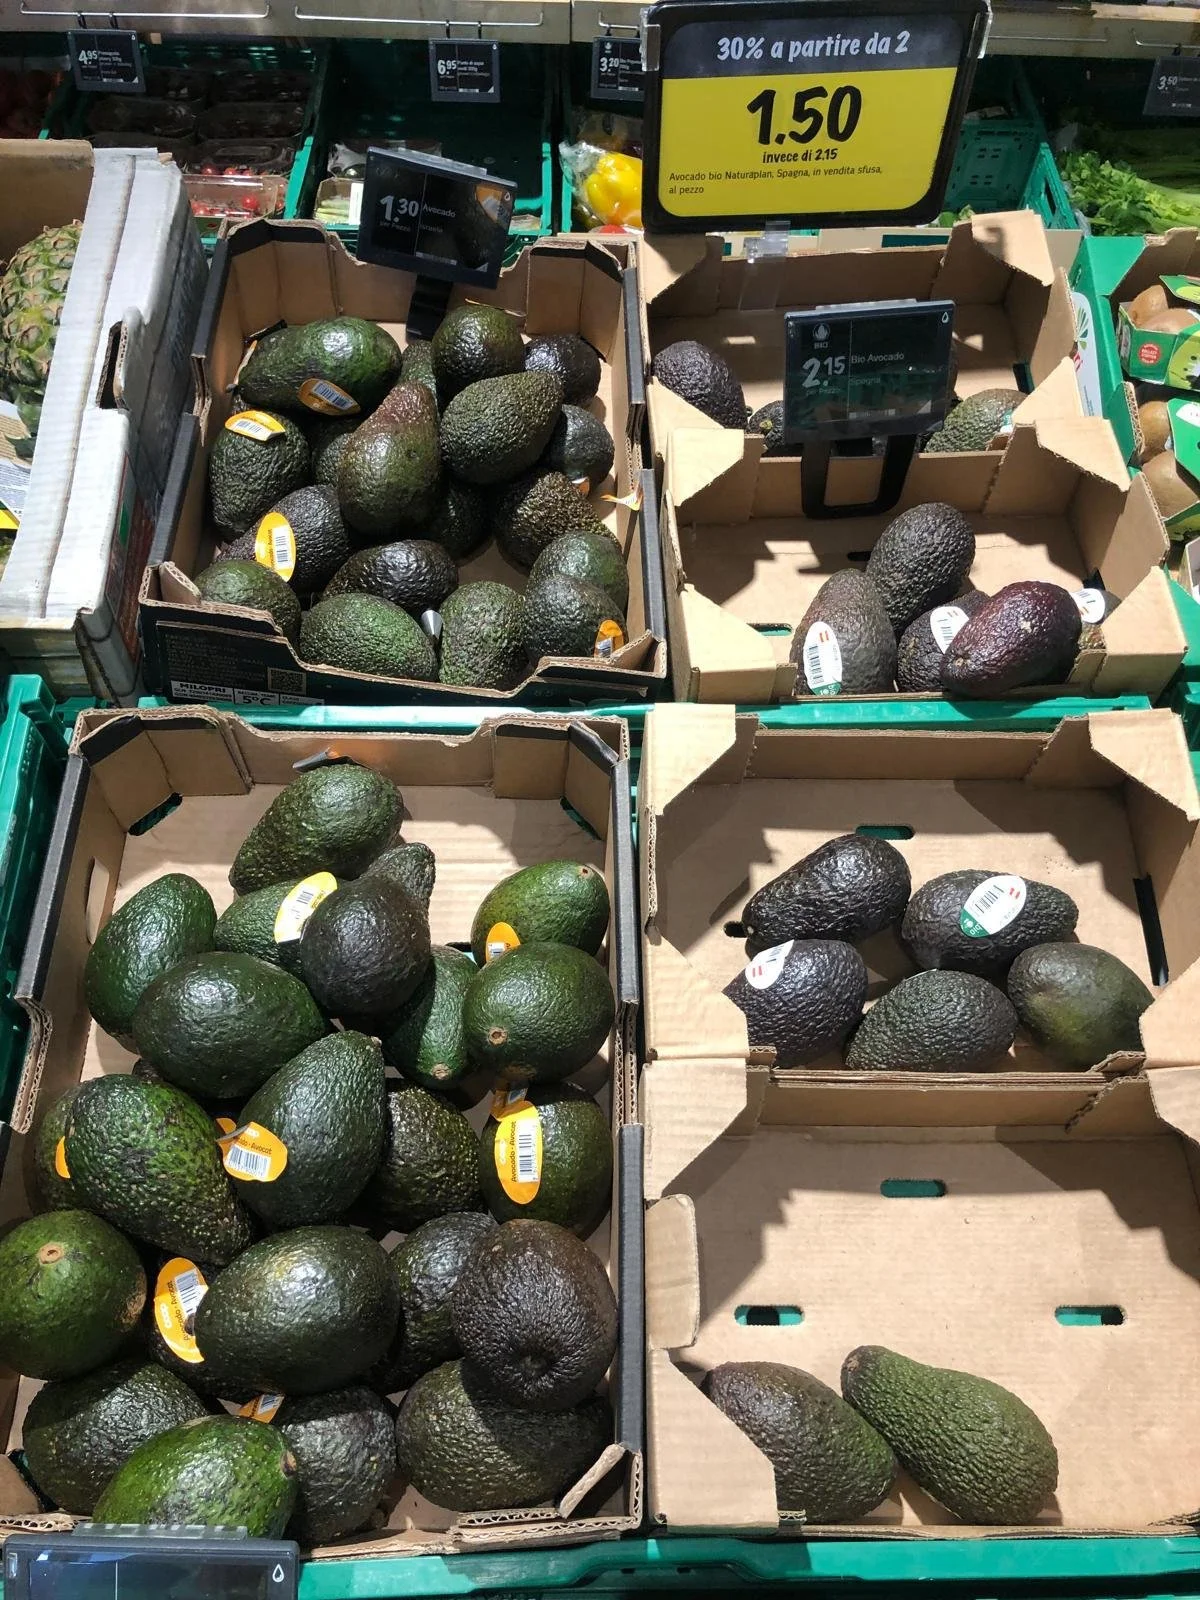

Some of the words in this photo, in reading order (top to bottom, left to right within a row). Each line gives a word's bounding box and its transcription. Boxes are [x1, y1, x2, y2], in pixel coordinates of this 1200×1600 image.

[716, 36, 765, 61] 30%
[770, 40, 784, 59] a
[788, 33, 861, 63] partire
[864, 32, 890, 55] da
[895, 30, 911, 54] 2
[78, 49, 98, 65] 4.95
[600, 57, 620, 72] 3.20
[437, 59, 457, 75] 6.95
[1157, 75, 1178, 90] 3.50
[746, 85, 863, 145] 1.50
[762, 151, 798, 164] invece
[801, 149, 812, 162] di
[814, 148, 839, 161] 2.15
[669, 171, 706, 181] Avocado
[708, 171, 723, 181] bio
[725, 169, 775, 181] Naturaplan,
[777, 167, 811, 180] Spagna,
[812, 167, 821, 177] in
[823, 166, 855, 176] vendita
[857, 164, 883, 175] sfusa,
[669, 185, 677, 194] al
[679, 186, 705, 196] pezzo
[380, 195, 420, 223] 1.30
[422, 203, 457, 218] Avocado
[814, 341, 829, 350] BIO
[851, 354, 866, 364] Bio
[867, 351, 905, 363] Avocado
[802, 356, 847, 389] 2.15
[179, 682, 227, 693] MILOPRI
